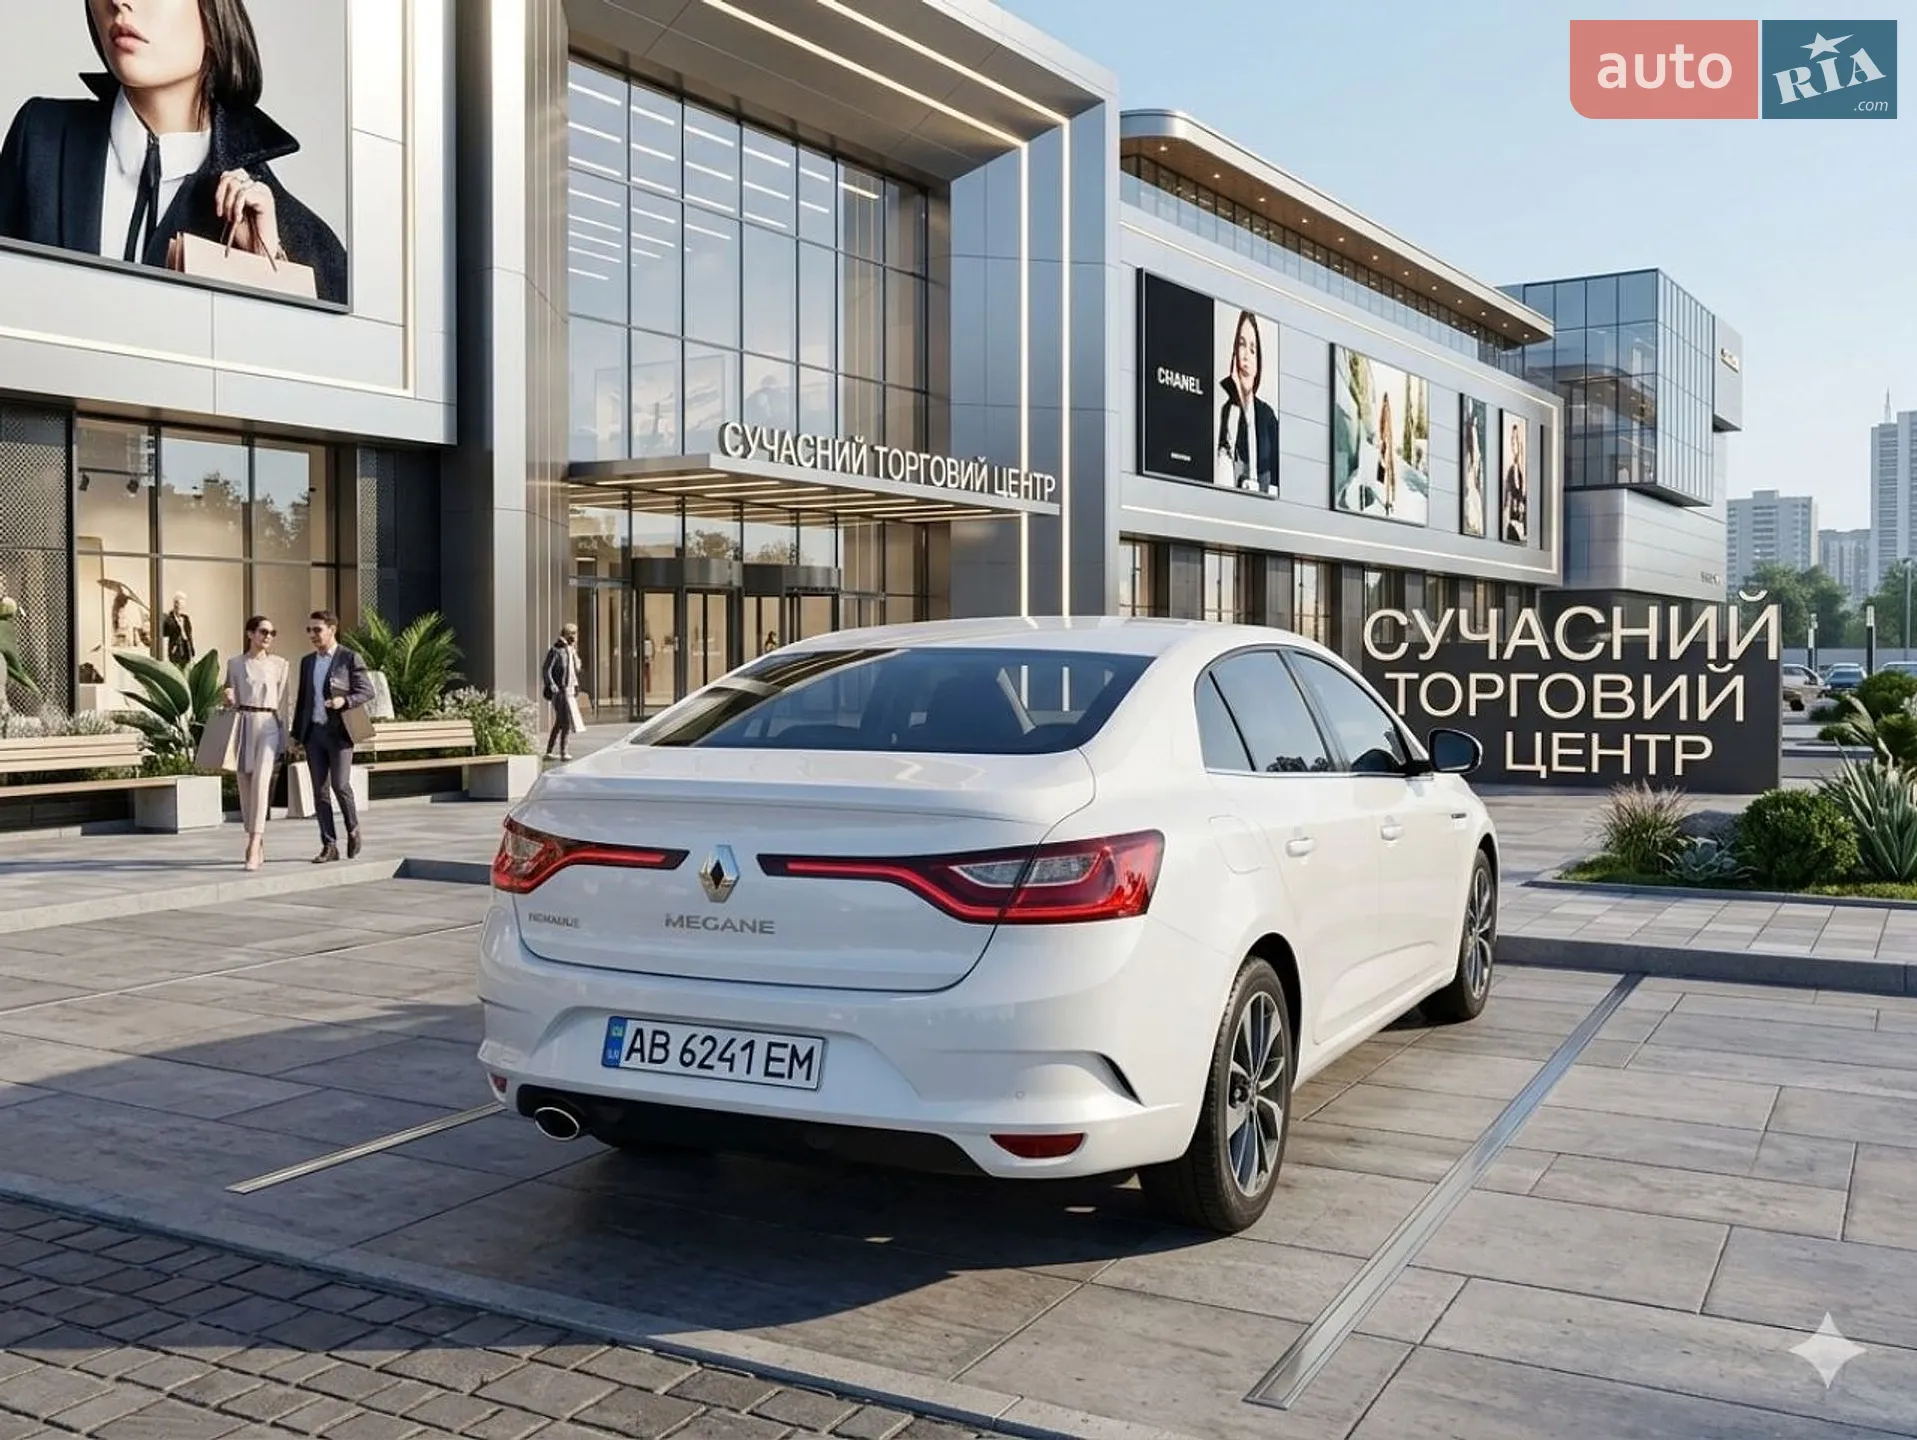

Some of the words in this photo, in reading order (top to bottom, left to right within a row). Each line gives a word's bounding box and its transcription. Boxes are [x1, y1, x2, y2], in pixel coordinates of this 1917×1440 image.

[1157, 366, 1204, 395] CHANEL
[721, 421, 868, 476] СУЧАСНИЙ
[874, 445, 989, 494] ТОРГОВИЙ
[994, 465, 1056, 502] ЦЕНТР
[1363, 589, 1781, 661] СУЧАСНИЙ
[1384, 662, 1746, 723] ТОРГОВИЙ
[1505, 731, 1713, 779] ЦЕНТР
[664, 913, 776, 935] MEGANE
[624, 1027, 671, 1066] AB
[678, 1033, 756, 1076] 6241
[763, 1041, 816, 1082] EM
